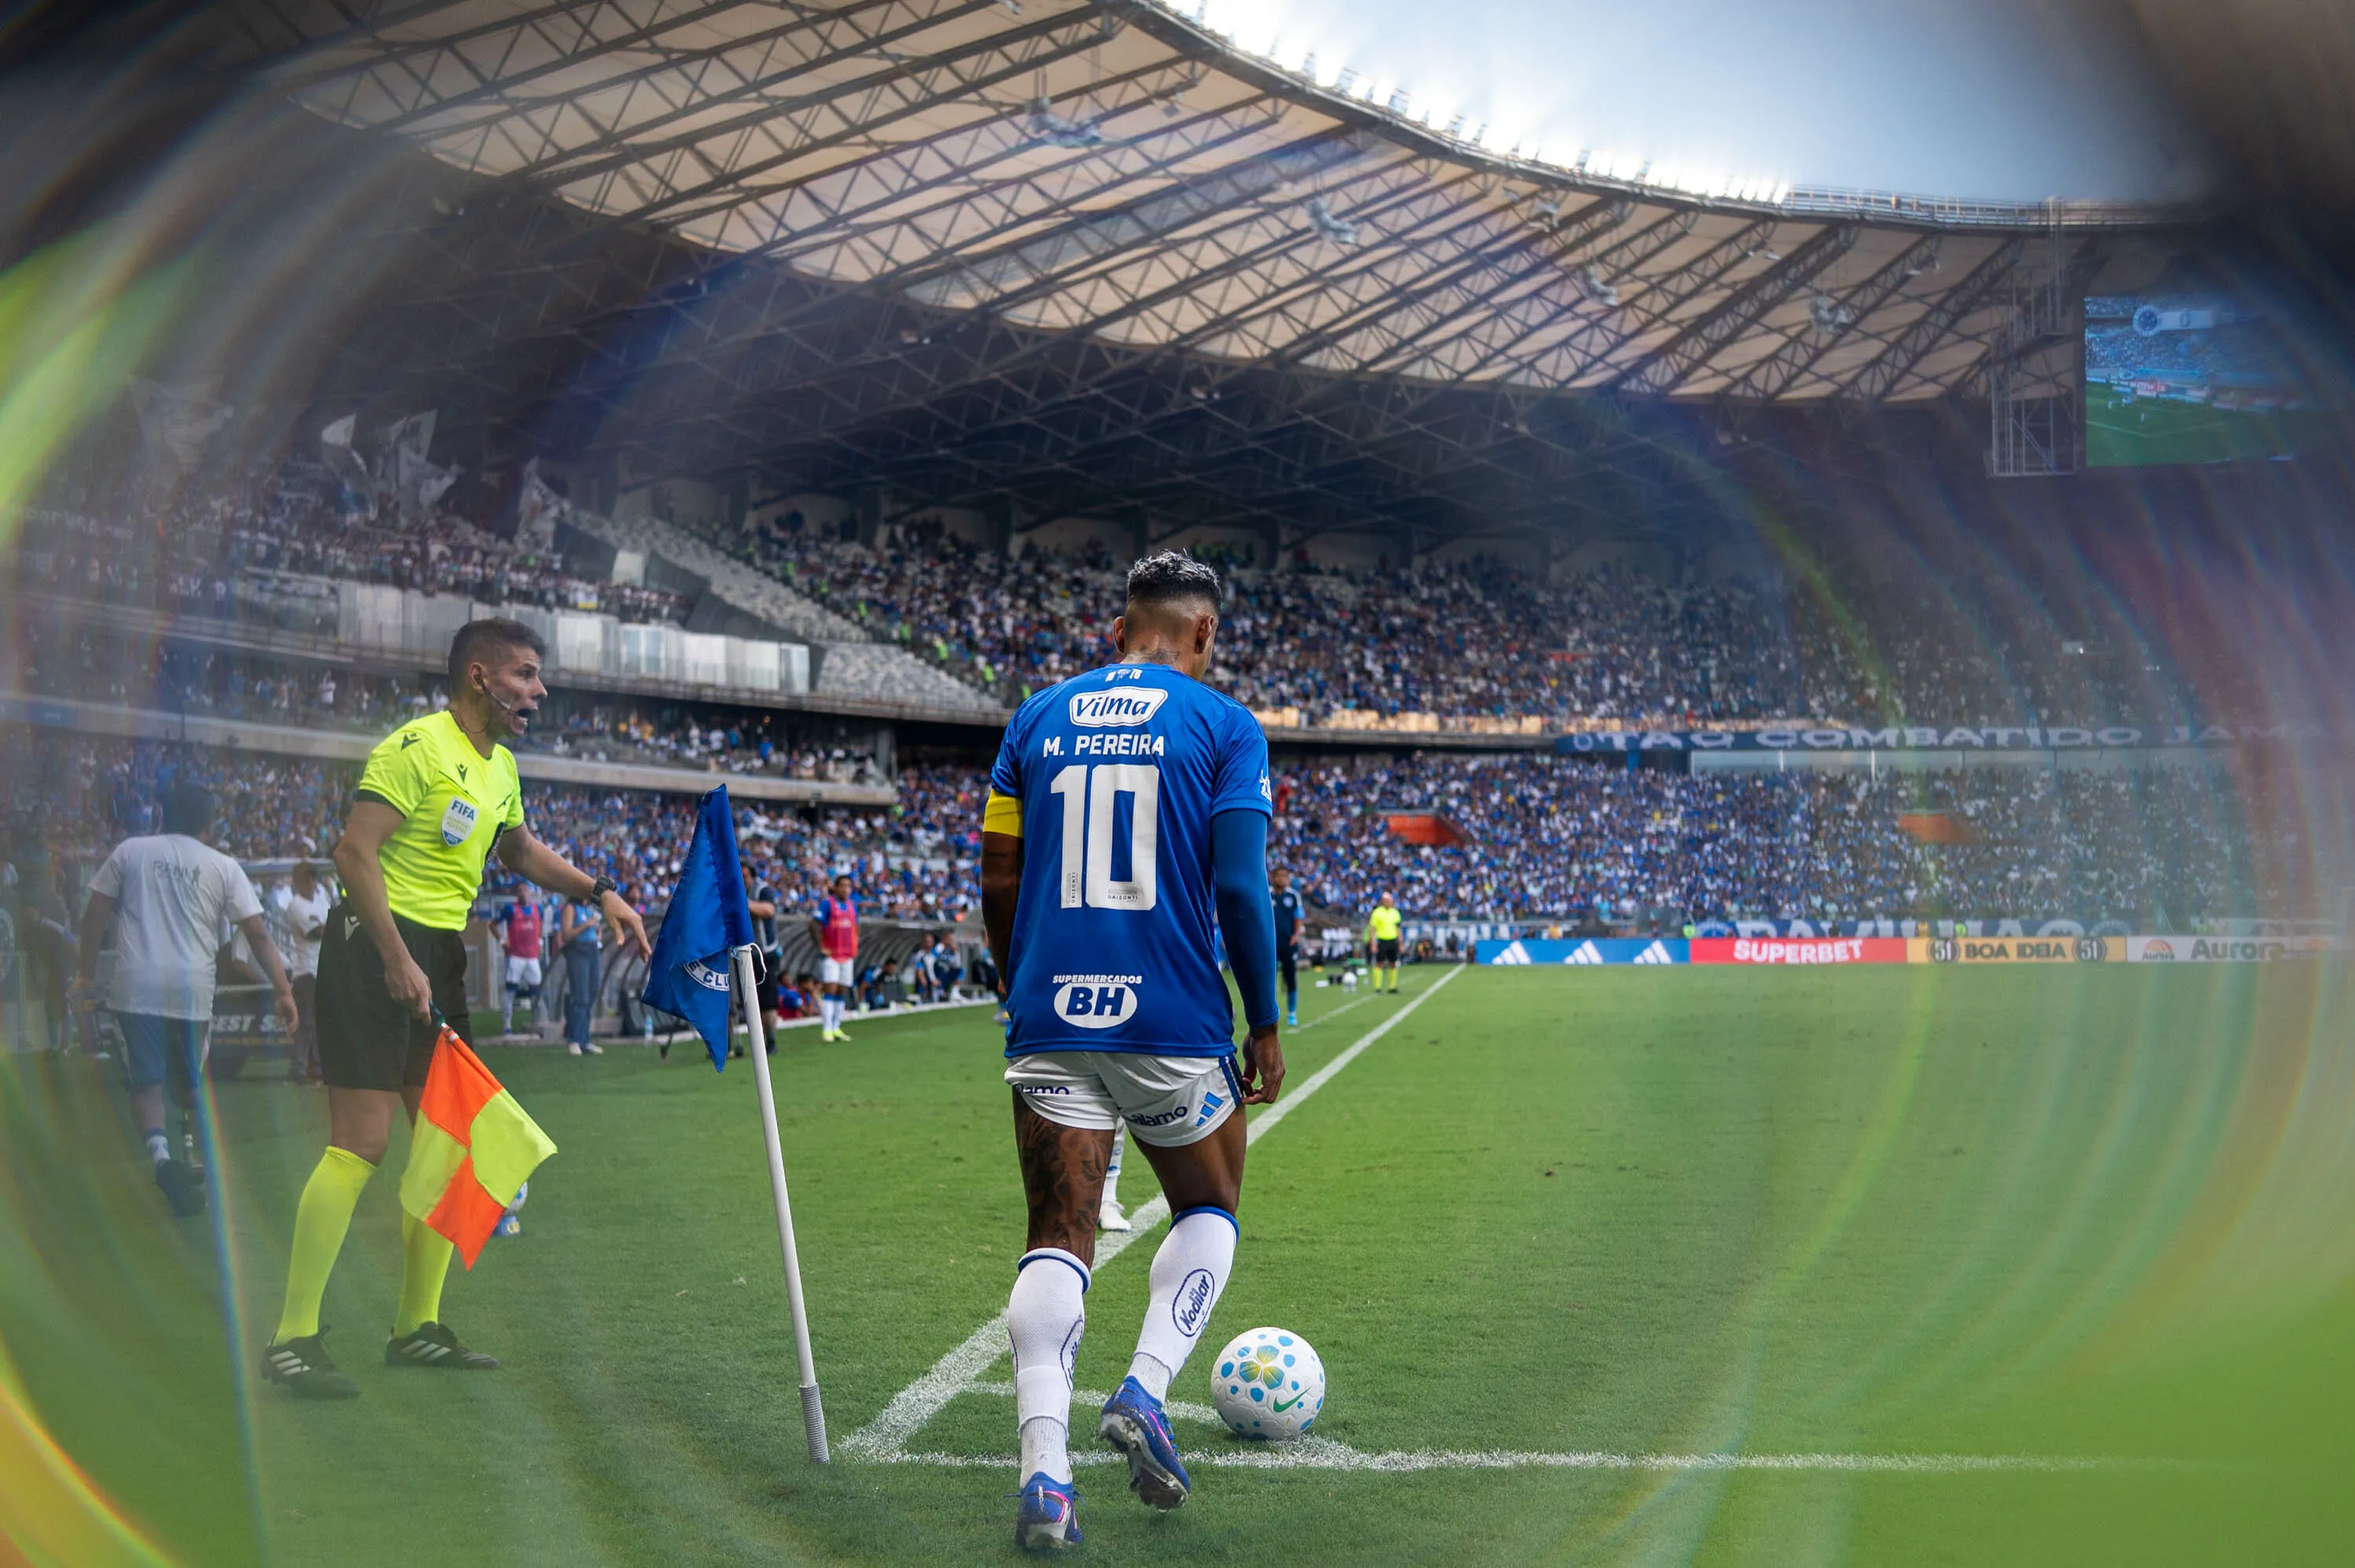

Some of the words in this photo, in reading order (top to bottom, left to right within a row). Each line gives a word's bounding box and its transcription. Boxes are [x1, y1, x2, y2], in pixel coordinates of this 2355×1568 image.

[1076, 696, 1152, 717] Vilma
[1042, 735, 1065, 758] M.
[1074, 734, 1165, 757] PEREIRA
[1754, 727, 2142, 749] COMBATIDO
[451, 800, 475, 822] FIFA
[1050, 763, 1160, 911] 10
[1732, 939, 1864, 965] SUPERBET
[1933, 938, 1953, 962] 51
[1965, 943, 2010, 960] BOA
[2080, 939, 2099, 961] 51
[1052, 974, 1143, 985] SUPERMERCADOS
[1065, 986, 1126, 1016] BH
[1129, 1105, 1188, 1127] alamo
[1179, 1274, 1210, 1332] Kodilar
